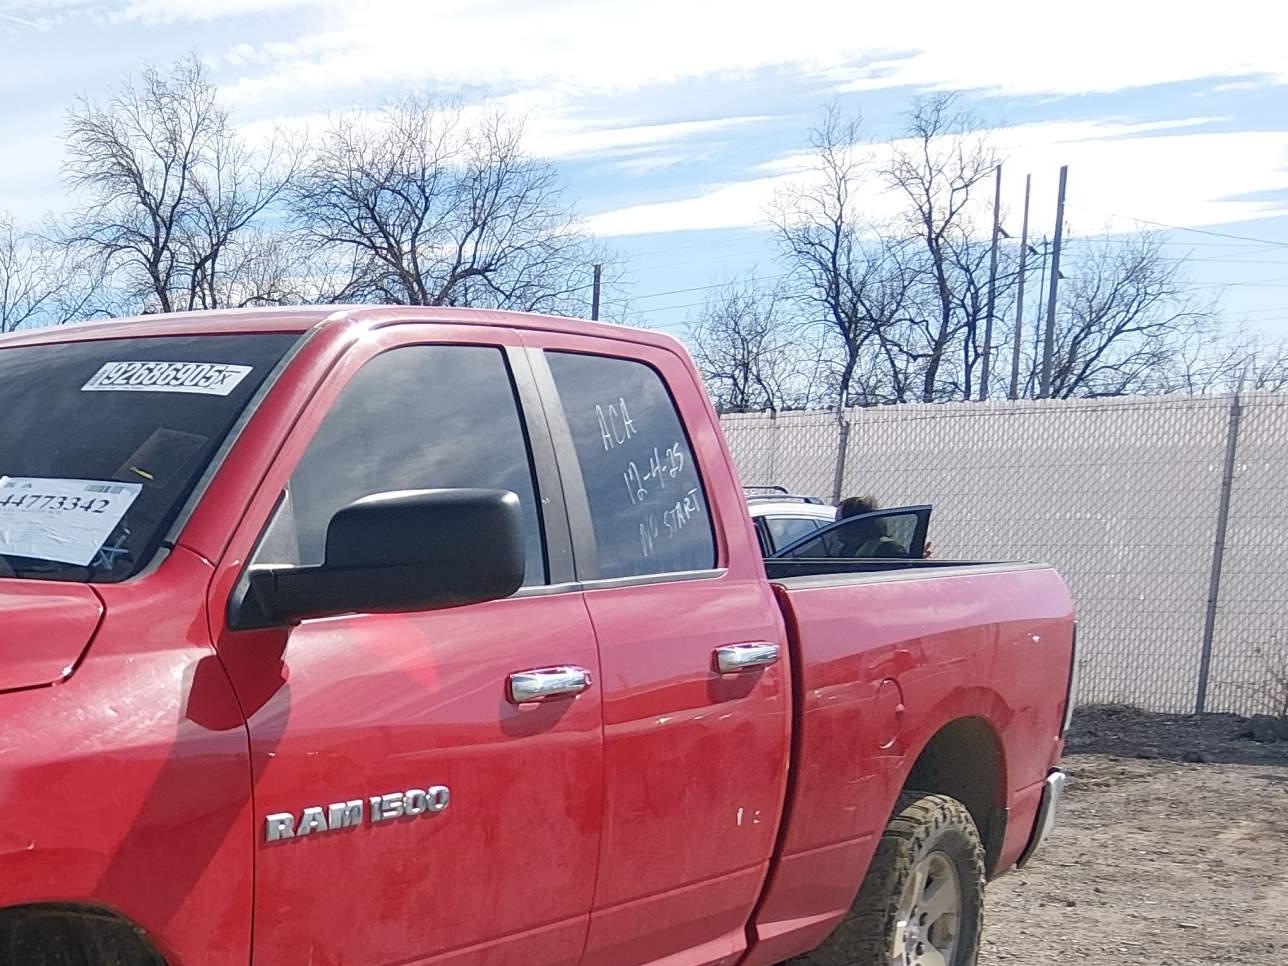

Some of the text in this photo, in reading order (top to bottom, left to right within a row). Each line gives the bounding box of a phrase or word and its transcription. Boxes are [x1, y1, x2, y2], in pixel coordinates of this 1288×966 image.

[99, 362, 220, 388] 92686905
[595, 397, 638, 452] ACA
[663, 487, 700, 538] START
[265, 785, 450, 842] RAM 1500
